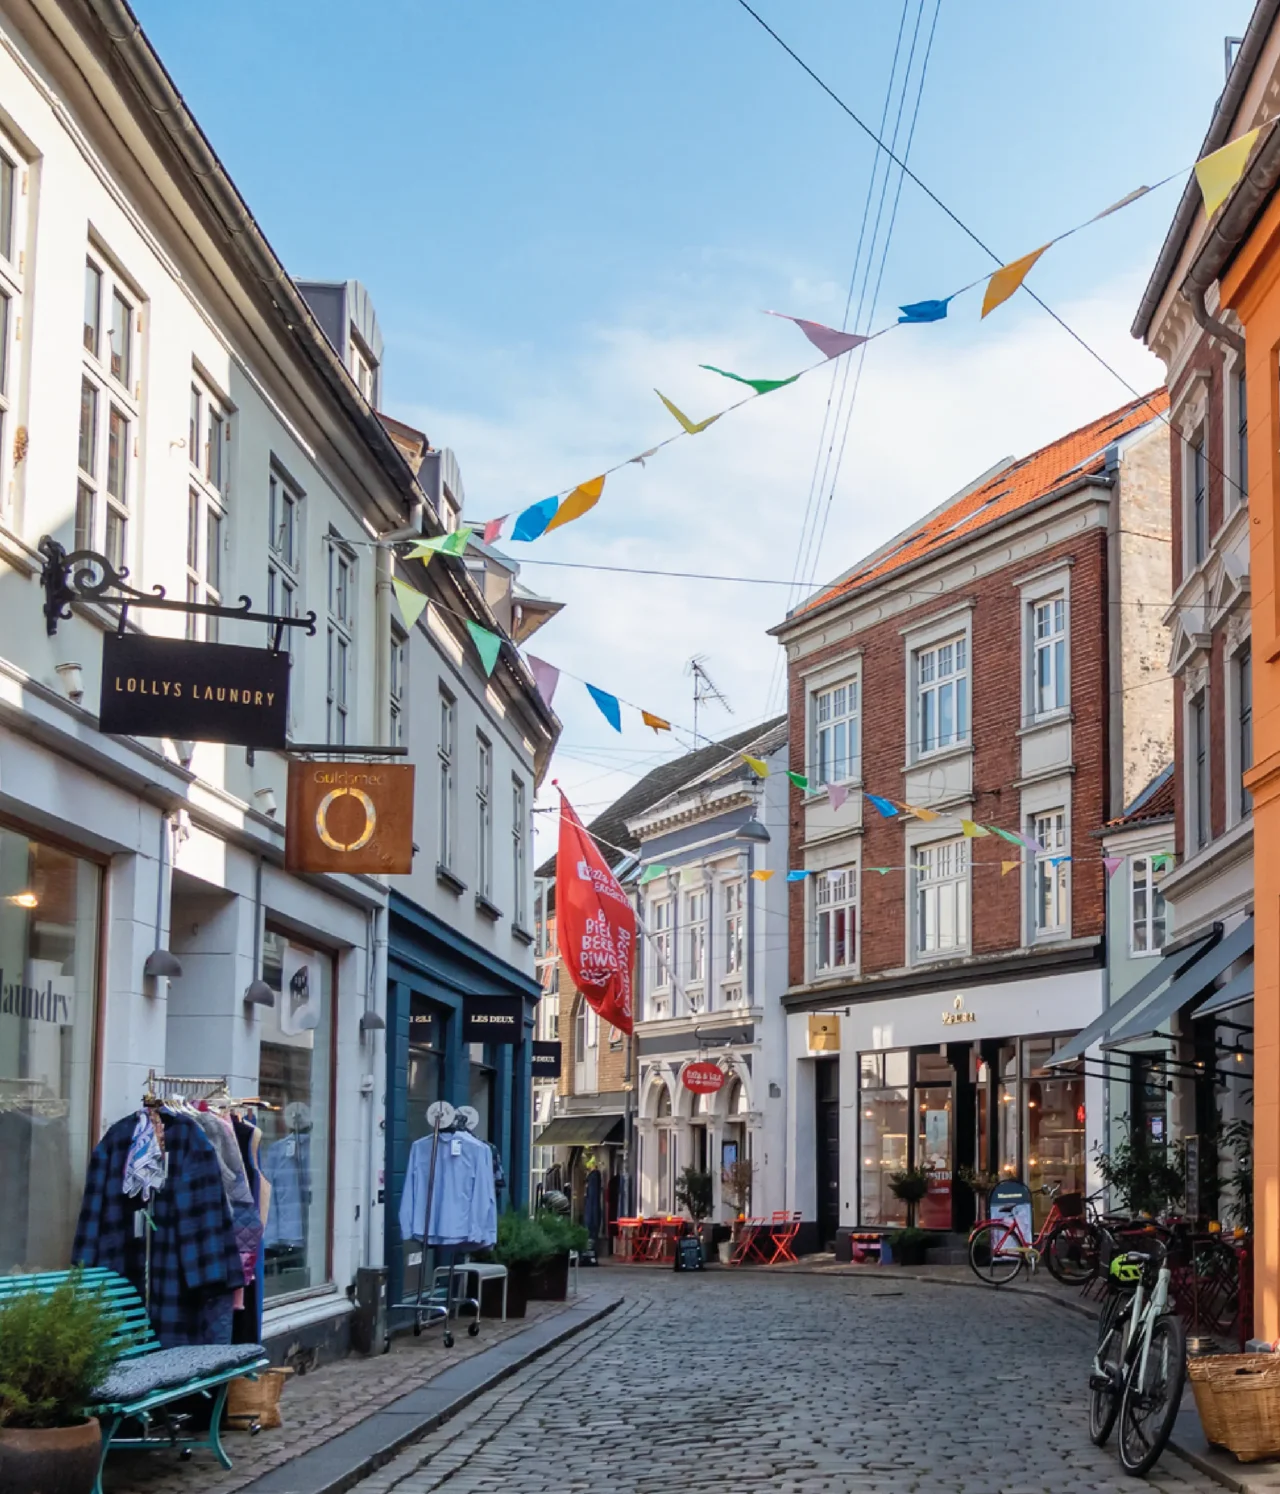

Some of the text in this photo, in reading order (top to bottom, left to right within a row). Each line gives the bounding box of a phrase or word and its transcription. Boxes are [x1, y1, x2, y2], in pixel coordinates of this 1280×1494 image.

[115, 676, 275, 707] LOLLYS LAUNDRY
[471, 1014, 514, 1024] LES DEUX
